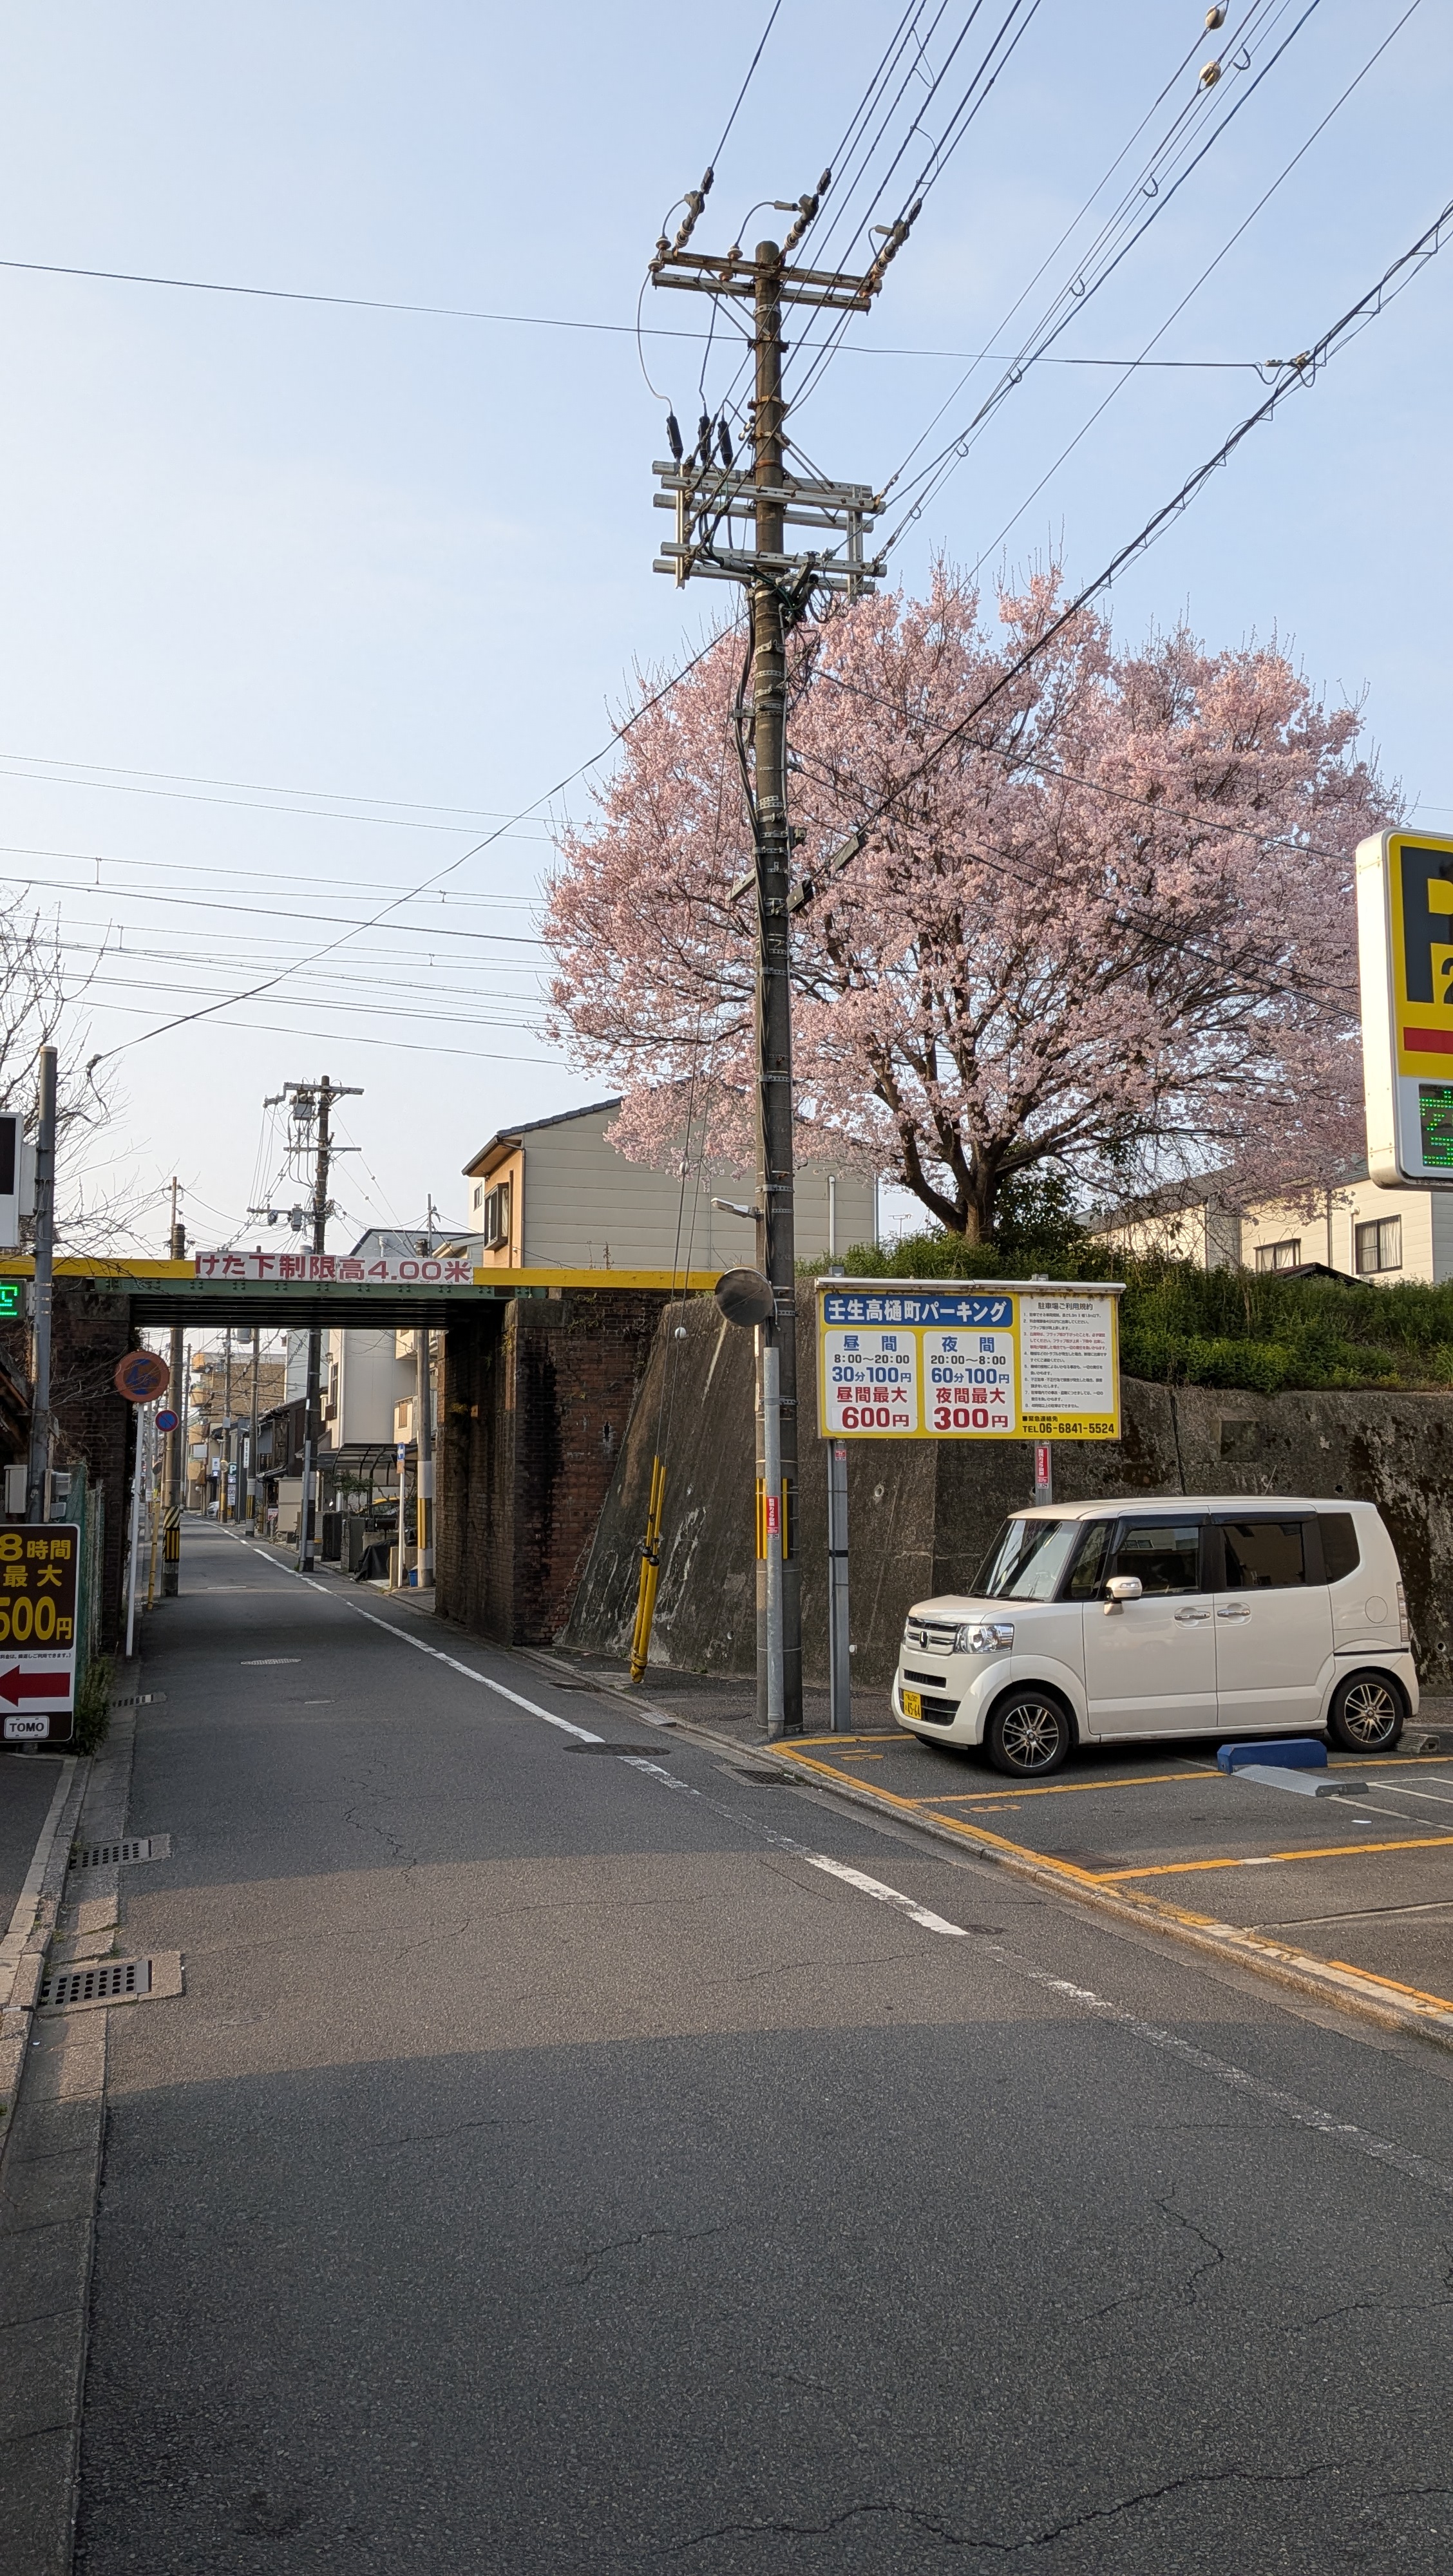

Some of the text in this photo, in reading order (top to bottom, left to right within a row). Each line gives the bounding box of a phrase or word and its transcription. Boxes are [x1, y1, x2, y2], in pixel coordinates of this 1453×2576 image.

[196, 1255, 472, 1282] けた下制限高4.00米
[828, 1299, 1007, 1322] 壬生高樋町パーキング
[837, 1387, 907, 1403] 昼間最大
[936, 1387, 1005, 1404] 夜間最大
[842, 1406, 909, 1429] 600円
[934, 1407, 1008, 1430] 300円
[229, 1464, 236, 1475] P
[3, 1564, 62, 1587] 最大
[9, 1722, 44, 1732] TOMO
